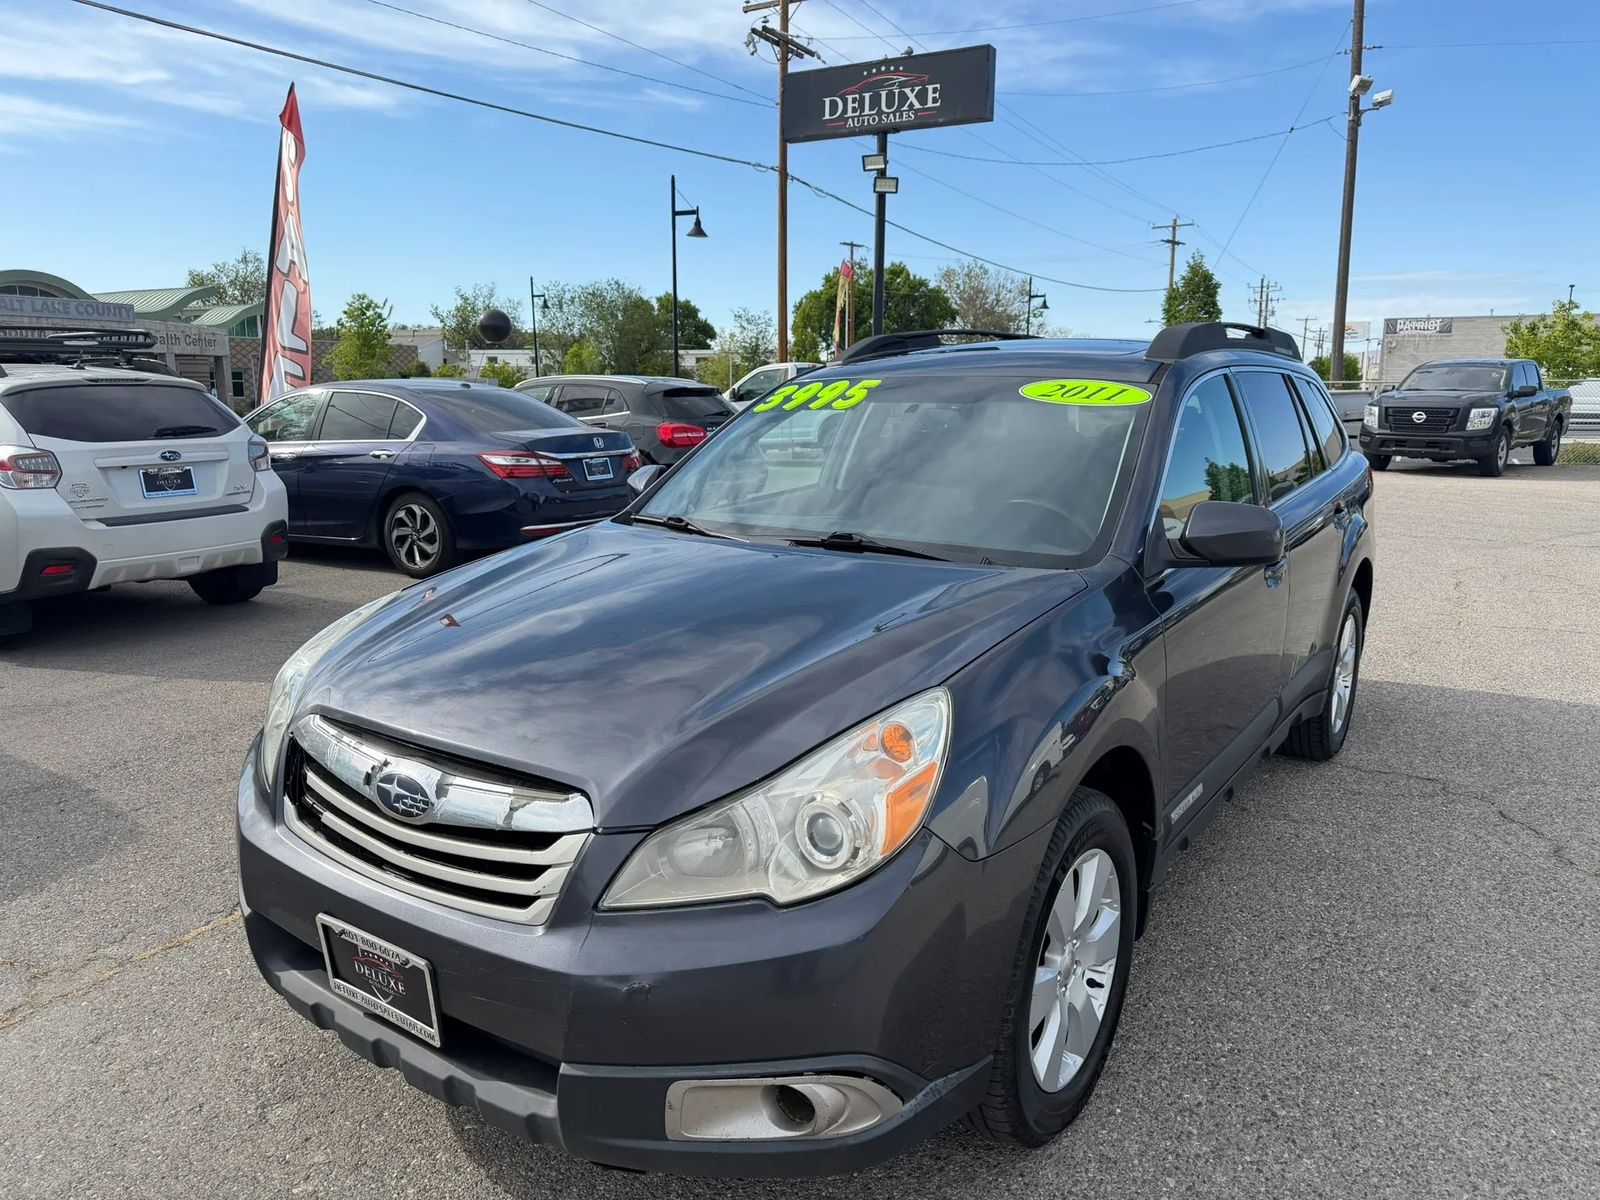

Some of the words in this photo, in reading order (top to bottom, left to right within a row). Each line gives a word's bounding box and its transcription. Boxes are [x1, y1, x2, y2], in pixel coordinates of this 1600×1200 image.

[822, 84, 941, 120] DELUXE
[846, 114, 878, 128] AUTO
[881, 111, 915, 124] SALES
[0, 298, 24, 313] ALT
[31, 300, 71, 315] LAKE
[75, 303, 134, 319] COUNTY
[147, 333, 182, 347] ealth
[184, 335, 218, 348] Center
[753, 379, 881, 412] 3995
[1038, 383, 1130, 401] 2011
[354, 961, 406, 996] DELUXE
